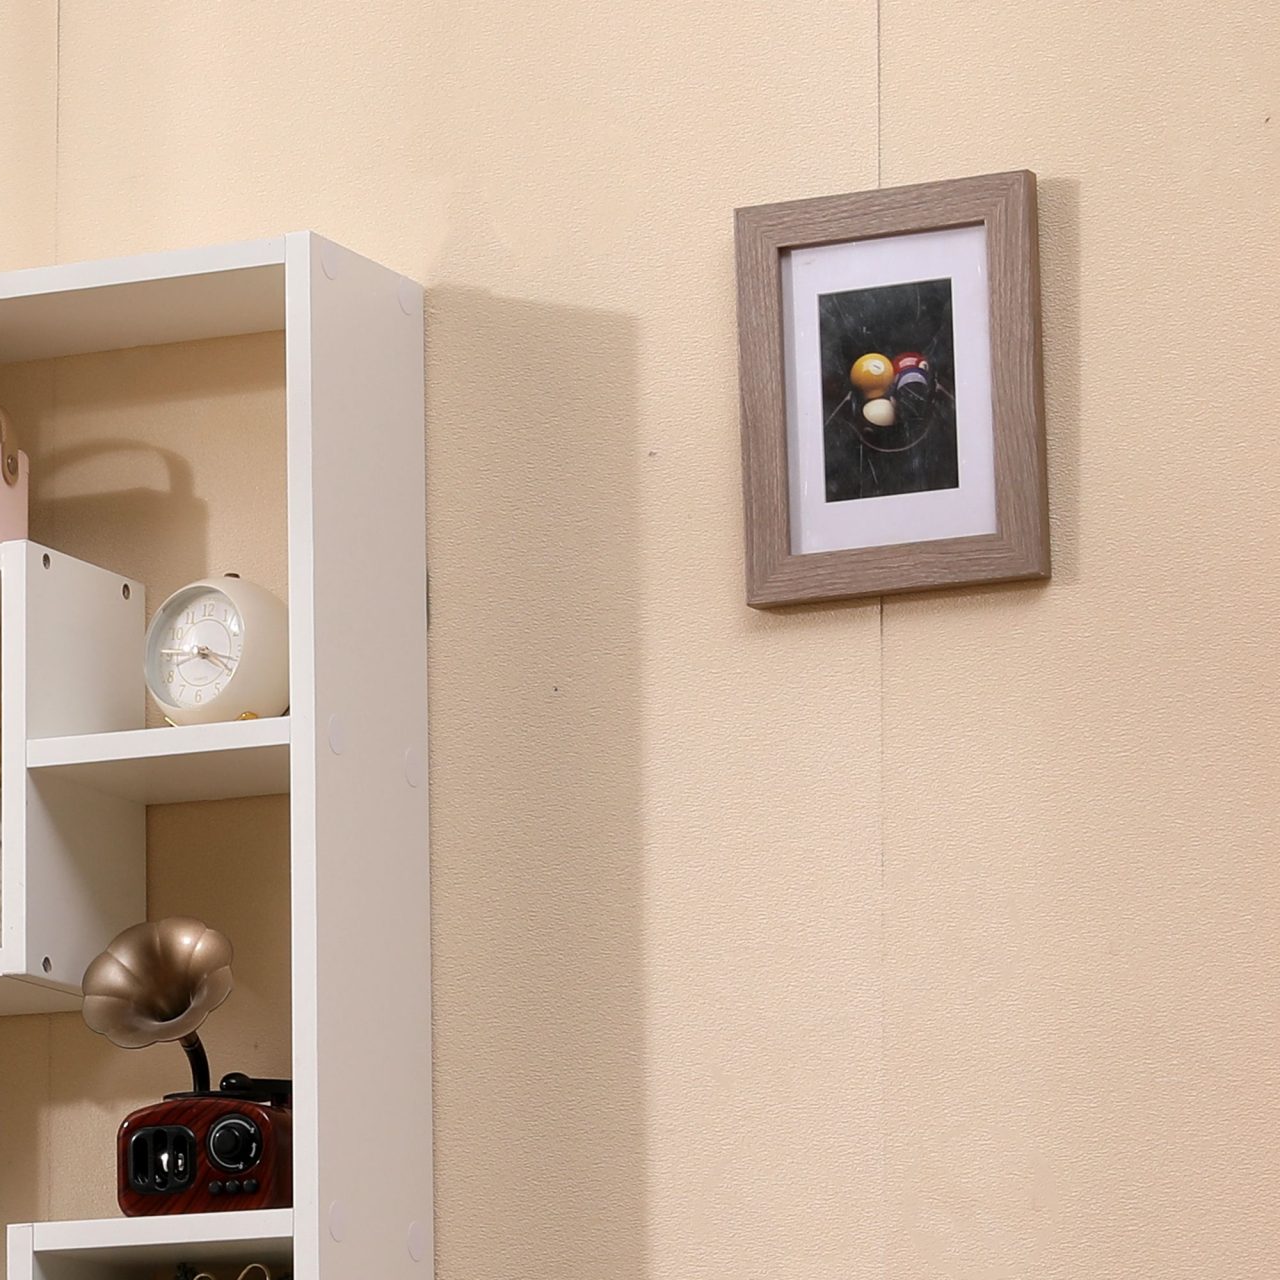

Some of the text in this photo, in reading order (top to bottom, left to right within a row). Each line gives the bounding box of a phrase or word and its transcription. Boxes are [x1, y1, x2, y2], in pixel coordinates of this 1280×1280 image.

[202, 603, 216, 618] 12
[185, 611, 195, 625] 11
[171, 627, 184, 641] 10
[194, 689, 202, 703] 6
